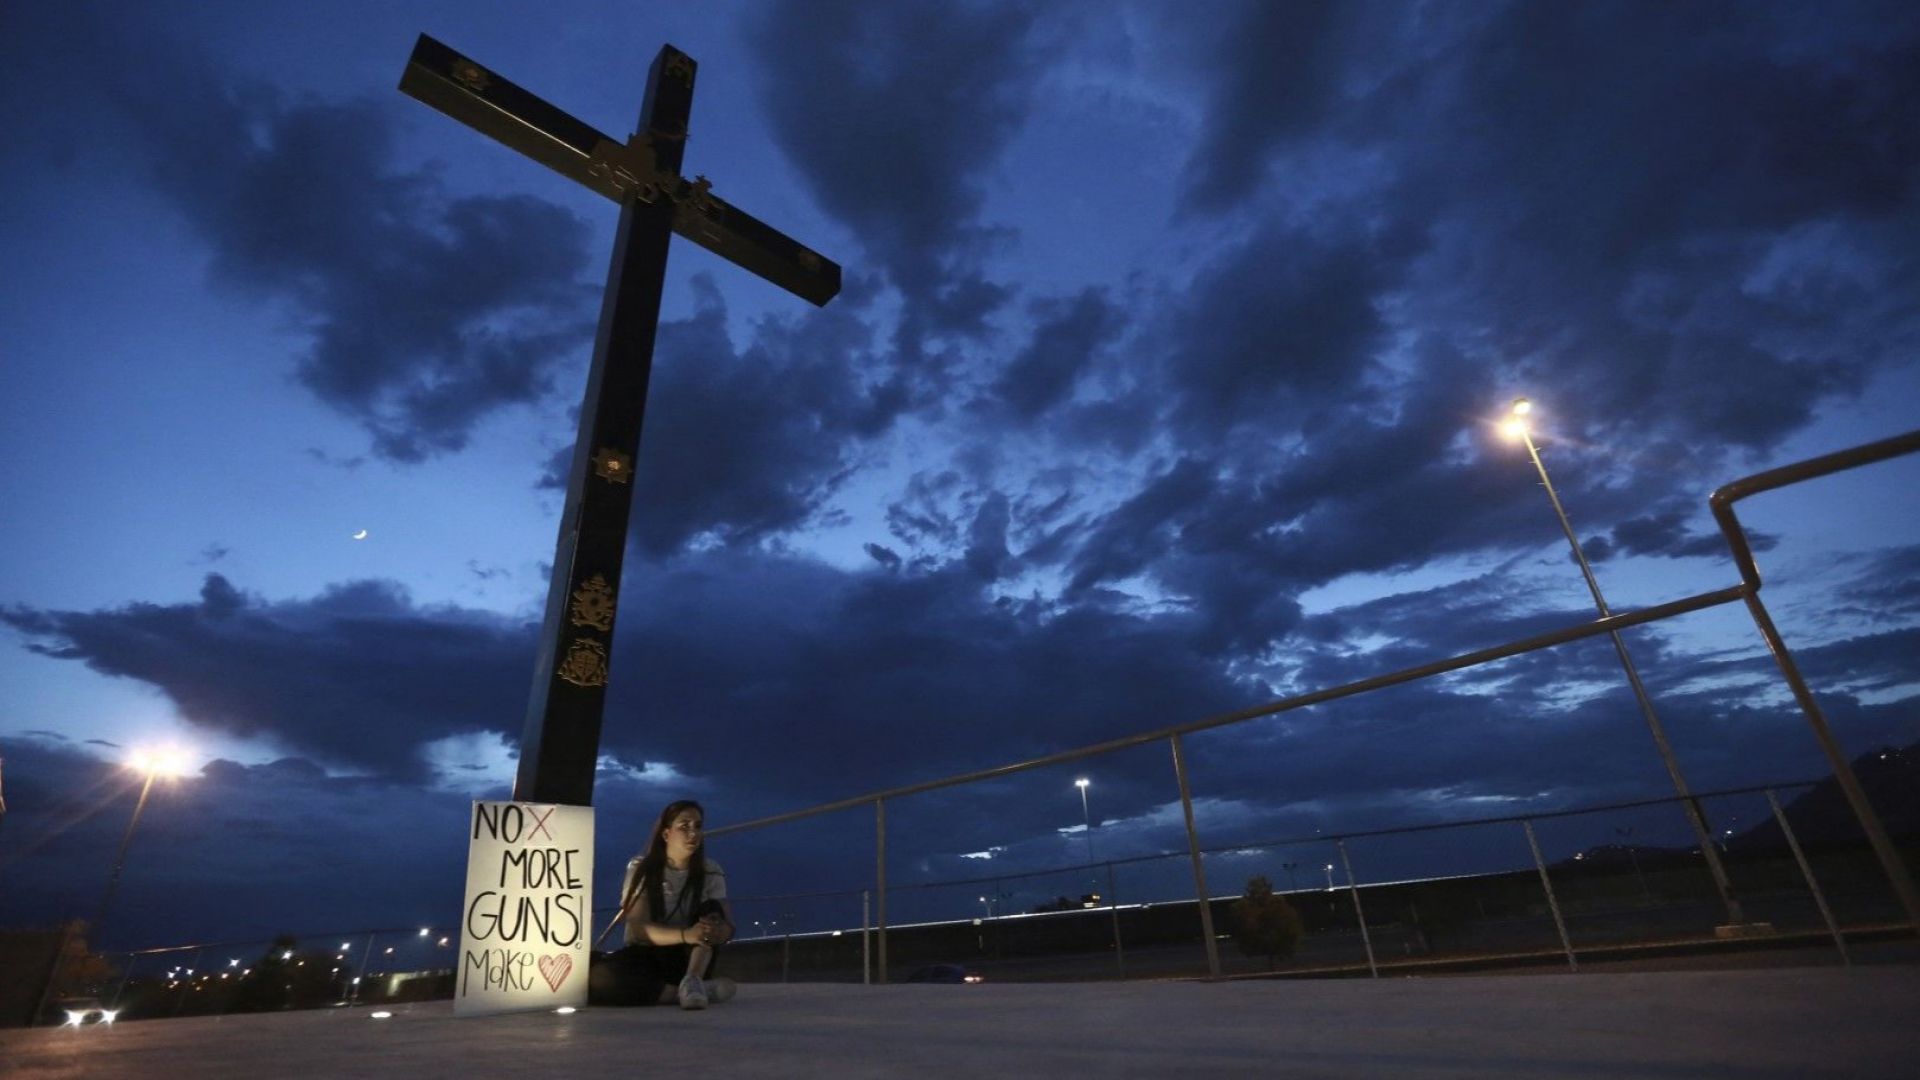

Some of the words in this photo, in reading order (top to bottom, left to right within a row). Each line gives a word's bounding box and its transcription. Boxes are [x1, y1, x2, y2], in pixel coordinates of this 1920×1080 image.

[474, 804, 524, 843] NO
[500, 848, 583, 889] MORE
[467, 891, 584, 950] GUNS!
